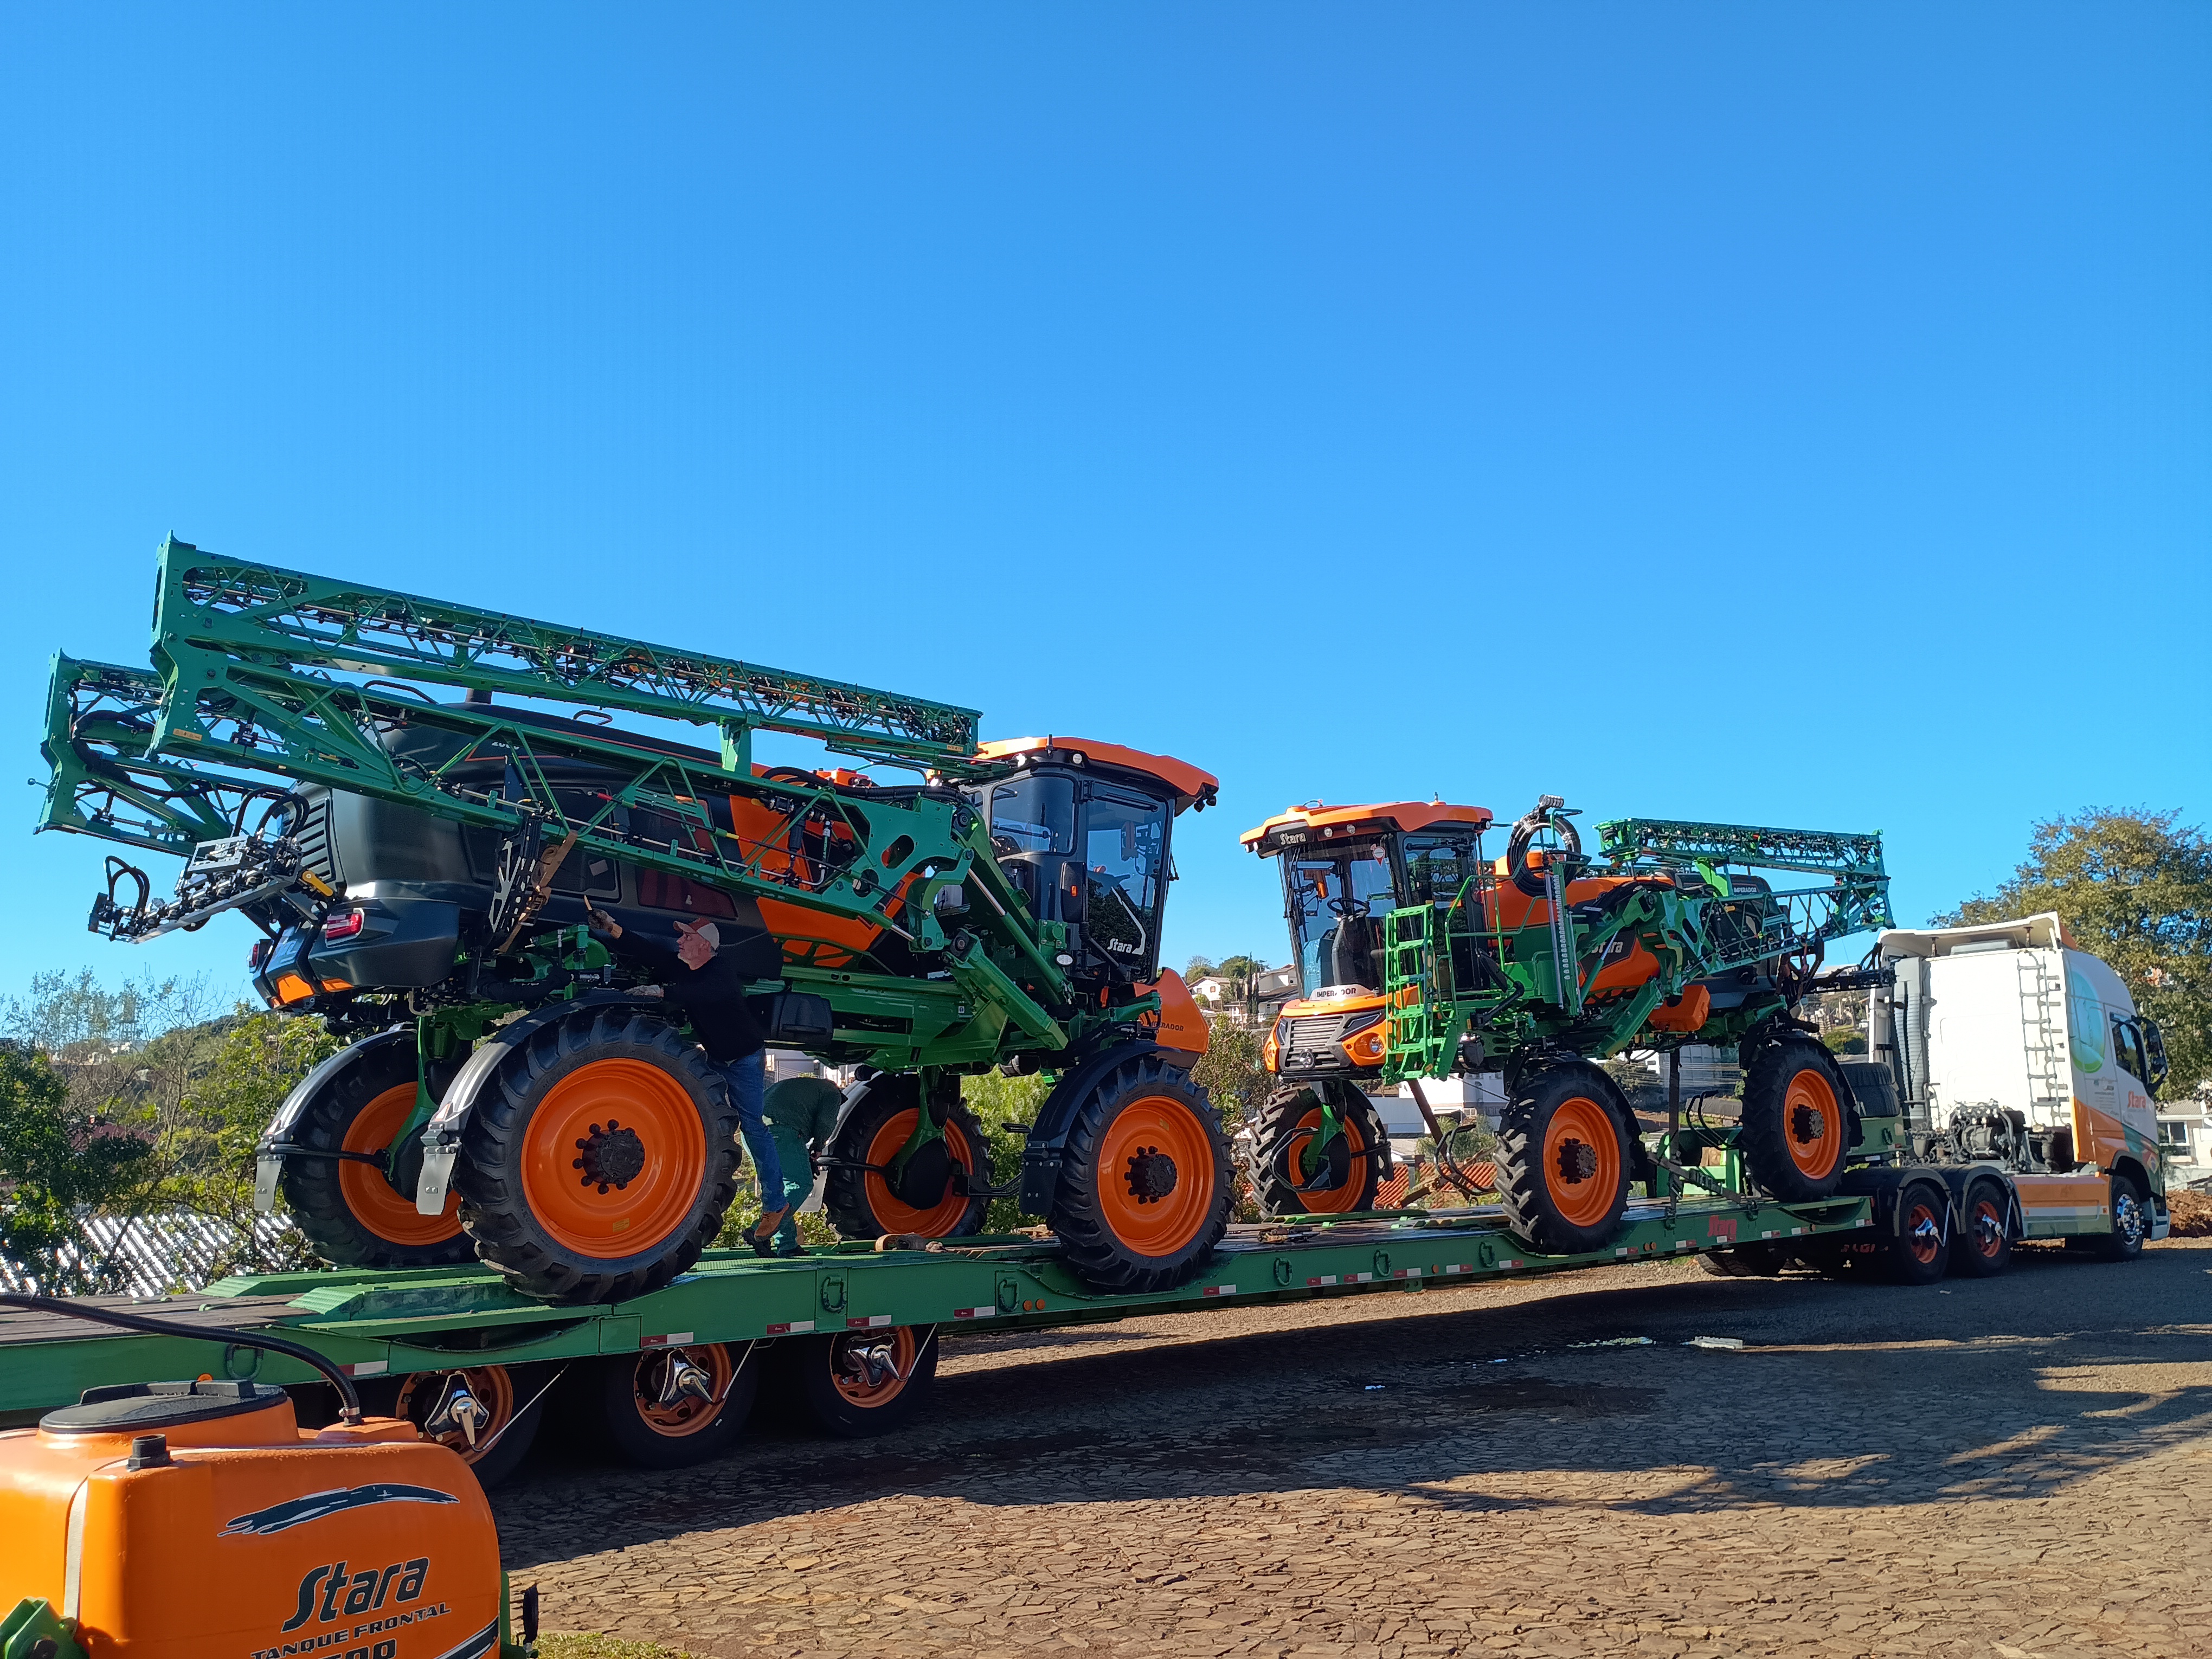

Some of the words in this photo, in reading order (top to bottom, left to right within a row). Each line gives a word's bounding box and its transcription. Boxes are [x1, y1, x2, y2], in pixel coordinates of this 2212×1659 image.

[1279, 833, 1307, 845] Stara
[1107, 938, 1133, 954] Stara
[1591, 941, 1623, 954] tra
[2127, 1090, 2146, 1109] Stara
[1707, 1214, 1738, 1237] Stara
[280, 1557, 430, 1634] Stara
[250, 1629, 349, 1659] TANQUE
[353, 1602, 452, 1639] FRONTAL
[317, 1638, 397, 1659] 00
